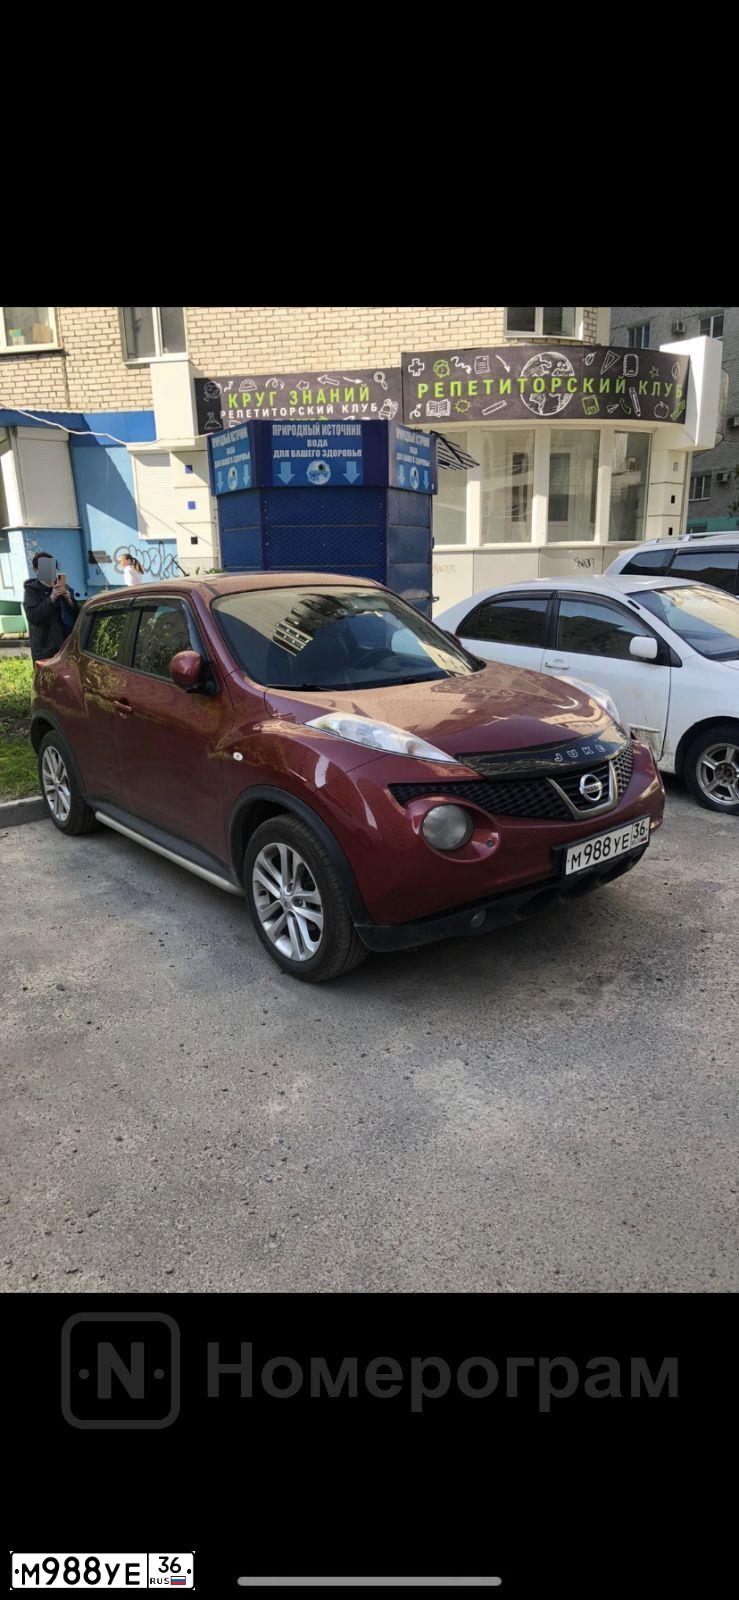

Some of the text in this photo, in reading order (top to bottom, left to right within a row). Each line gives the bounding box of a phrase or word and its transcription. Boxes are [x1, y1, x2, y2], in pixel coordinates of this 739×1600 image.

[228, 384, 371, 409] КРУГ ЗНАНИЙ
[417, 376, 683, 399] РЕПЕТИТОРСКИЙ КЛУБ
[220, 402, 378, 419] РЕПЕТИТОРСКИЙ КЛУБ
[272, 422, 362, 438] ПРИРОДНЫЙ ИСТОЧНИК
[307, 439, 328, 448] ВОДА
[273, 449, 362, 459] ДЛЯ ВАШЕГО ЗДОРОВЬЯ
[554, 744, 606, 763] JUKE
[632, 821, 646, 840] 36
